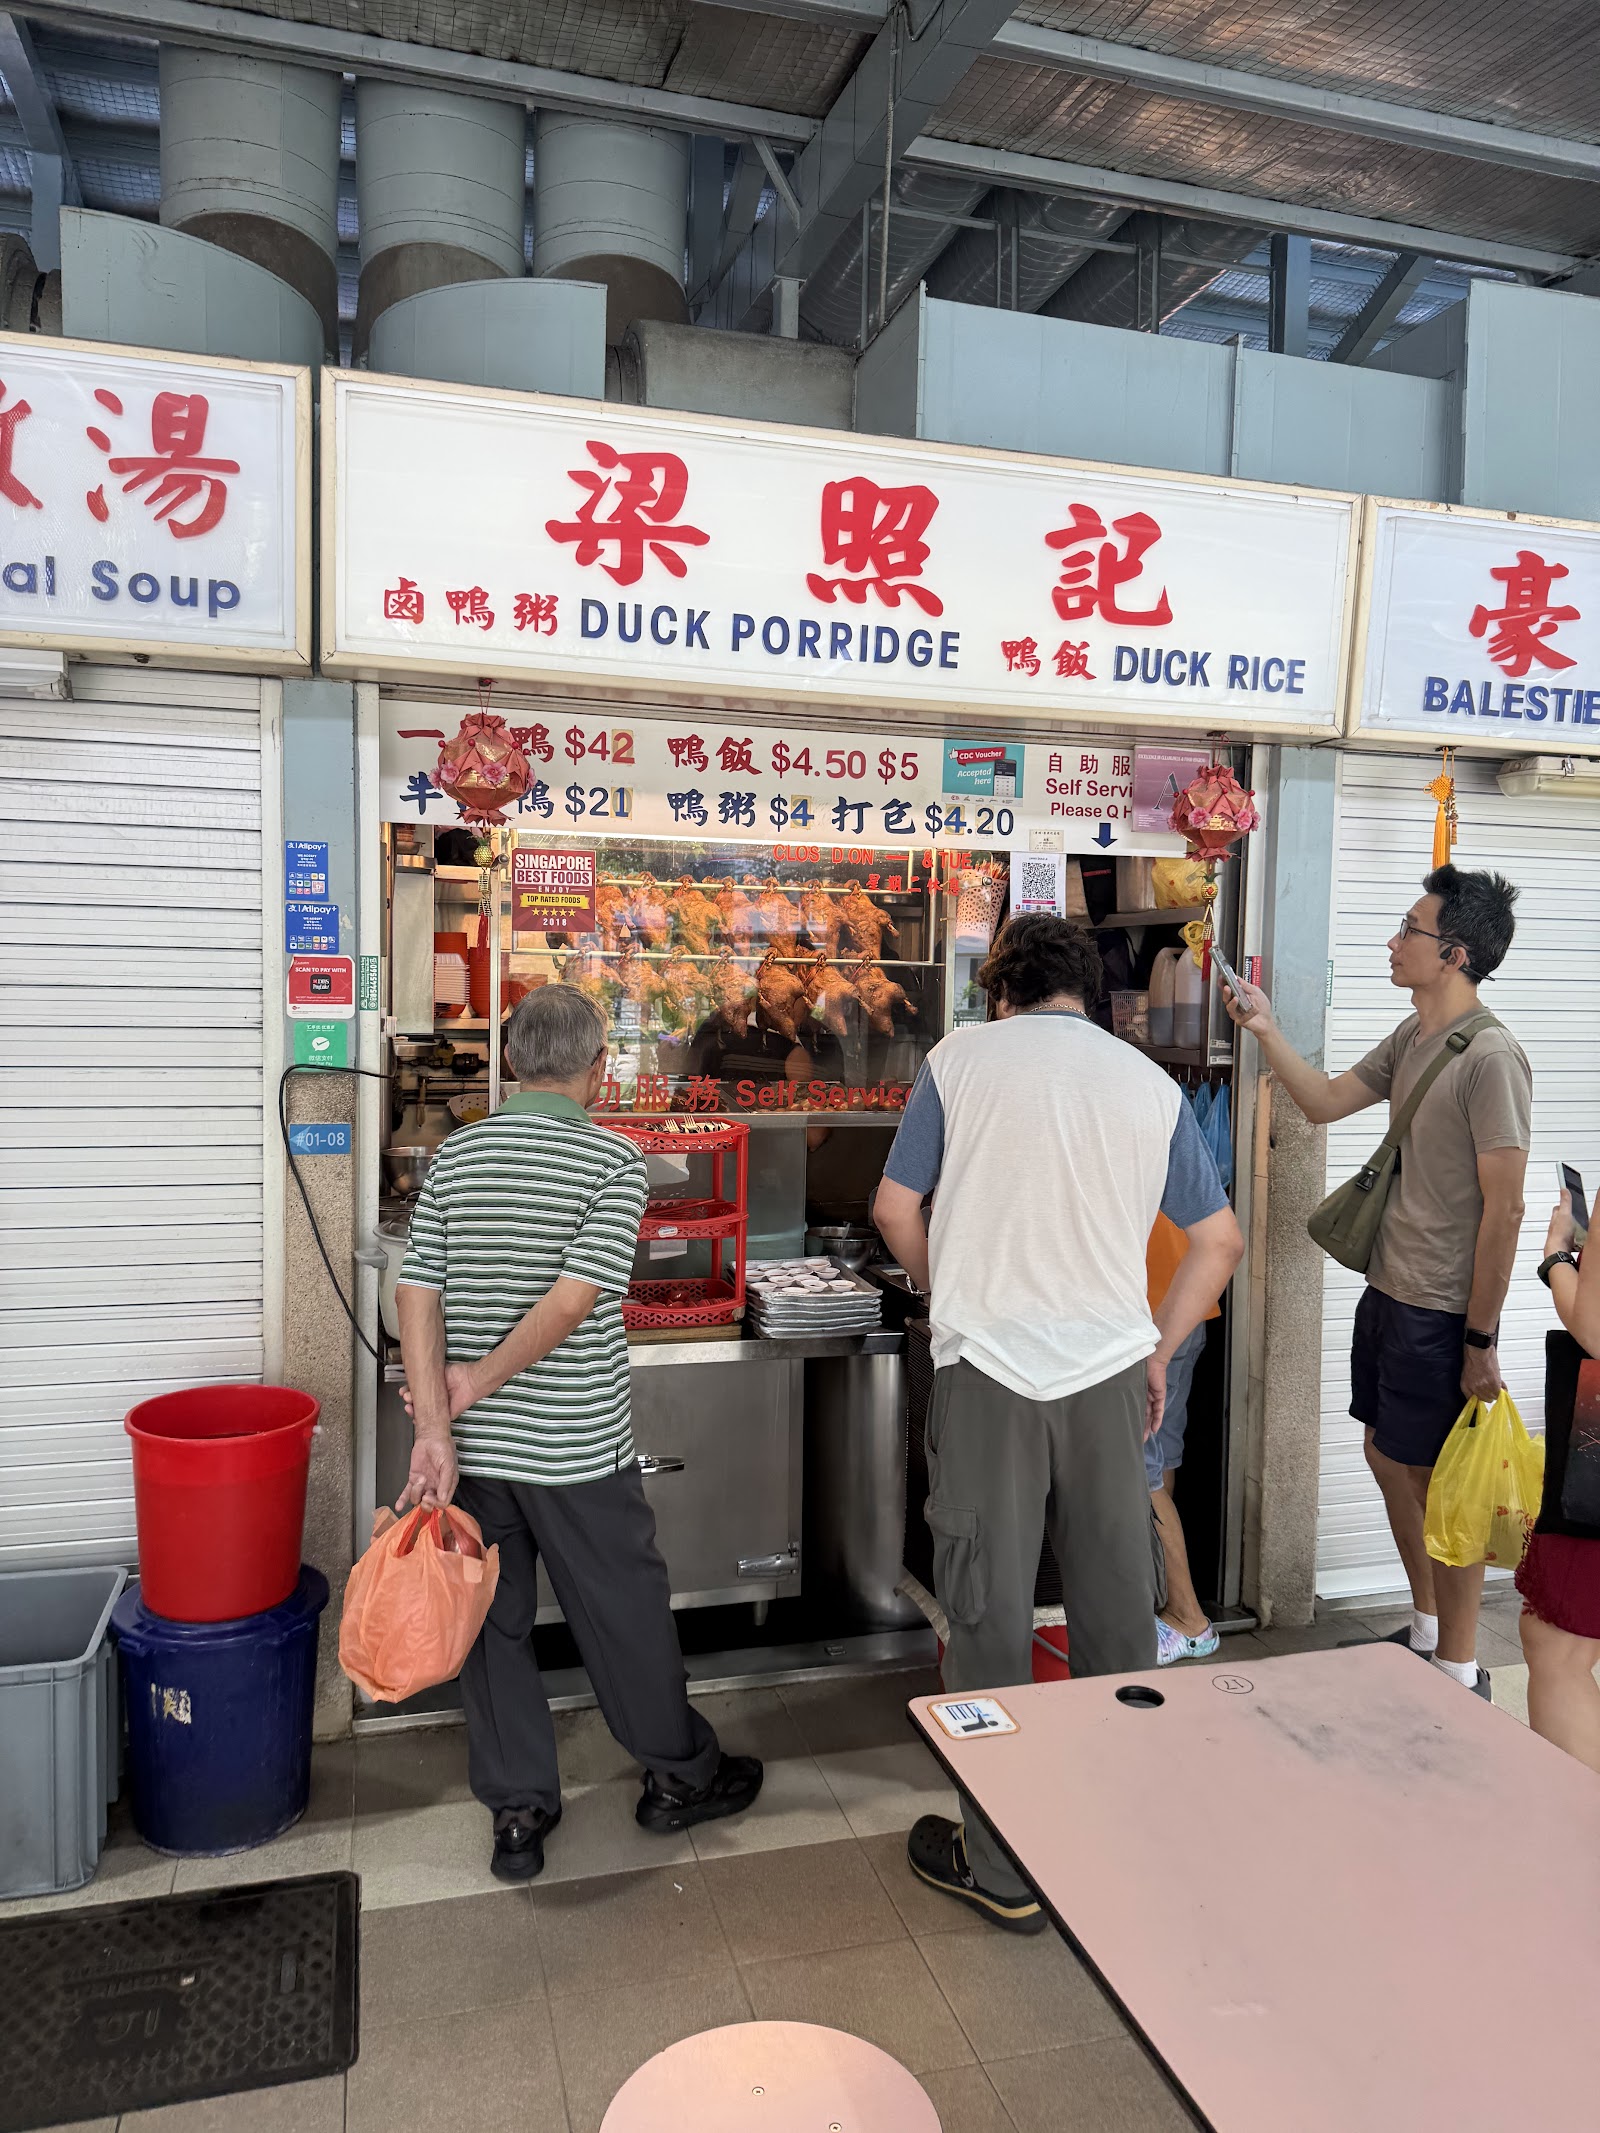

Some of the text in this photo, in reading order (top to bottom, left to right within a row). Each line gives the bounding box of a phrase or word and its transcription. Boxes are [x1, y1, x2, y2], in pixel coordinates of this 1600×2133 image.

[545, 441, 1174, 627] 梁照記
[91, 559, 241, 618] Soup
[1469, 550, 1581, 677] 豪
[581, 598, 711, 651] DUCK
[732, 611, 960, 669] PORRIDGE
[1001, 637, 1096, 681] 鴨飯
[1114, 645, 1210, 689] DUCK
[1227, 653, 1306, 694] RICE
[1423, 676, 1600, 725] BALESTIE
[565, 725, 635, 766] $42
[667, 733, 763, 776] 鴨飯
[771, 740, 867, 779] $4.50
[877, 748, 919, 785] $5
[959, 750, 1002, 760] CDC Voucher
[957, 768, 992, 778] Accepted
[1046, 778, 1083, 796] Self
[565, 782, 632, 822] $21
[667, 788, 757, 827] 鴨粥
[769, 793, 815, 832] $4
[924, 801, 1015, 837] $4.20
[1051, 802, 1102, 818] Please
[1106, 805, 1119, 819] Q
[515, 854, 592, 870] SINGAPORE
[773, 844, 820, 863] CLOS
[848, 848, 875, 865] ON
[922, 850, 934, 868] &
[938, 852, 973, 870] TUE
[517, 870, 590, 884] BEST FOODS
[561, 896, 581, 904] FOODS
[302, 905, 337, 914] Alipay+
[543, 918, 567, 926] 2018
[736, 1080, 913, 1108] Self Servic
[296, 1132, 345, 1146] #01-08
